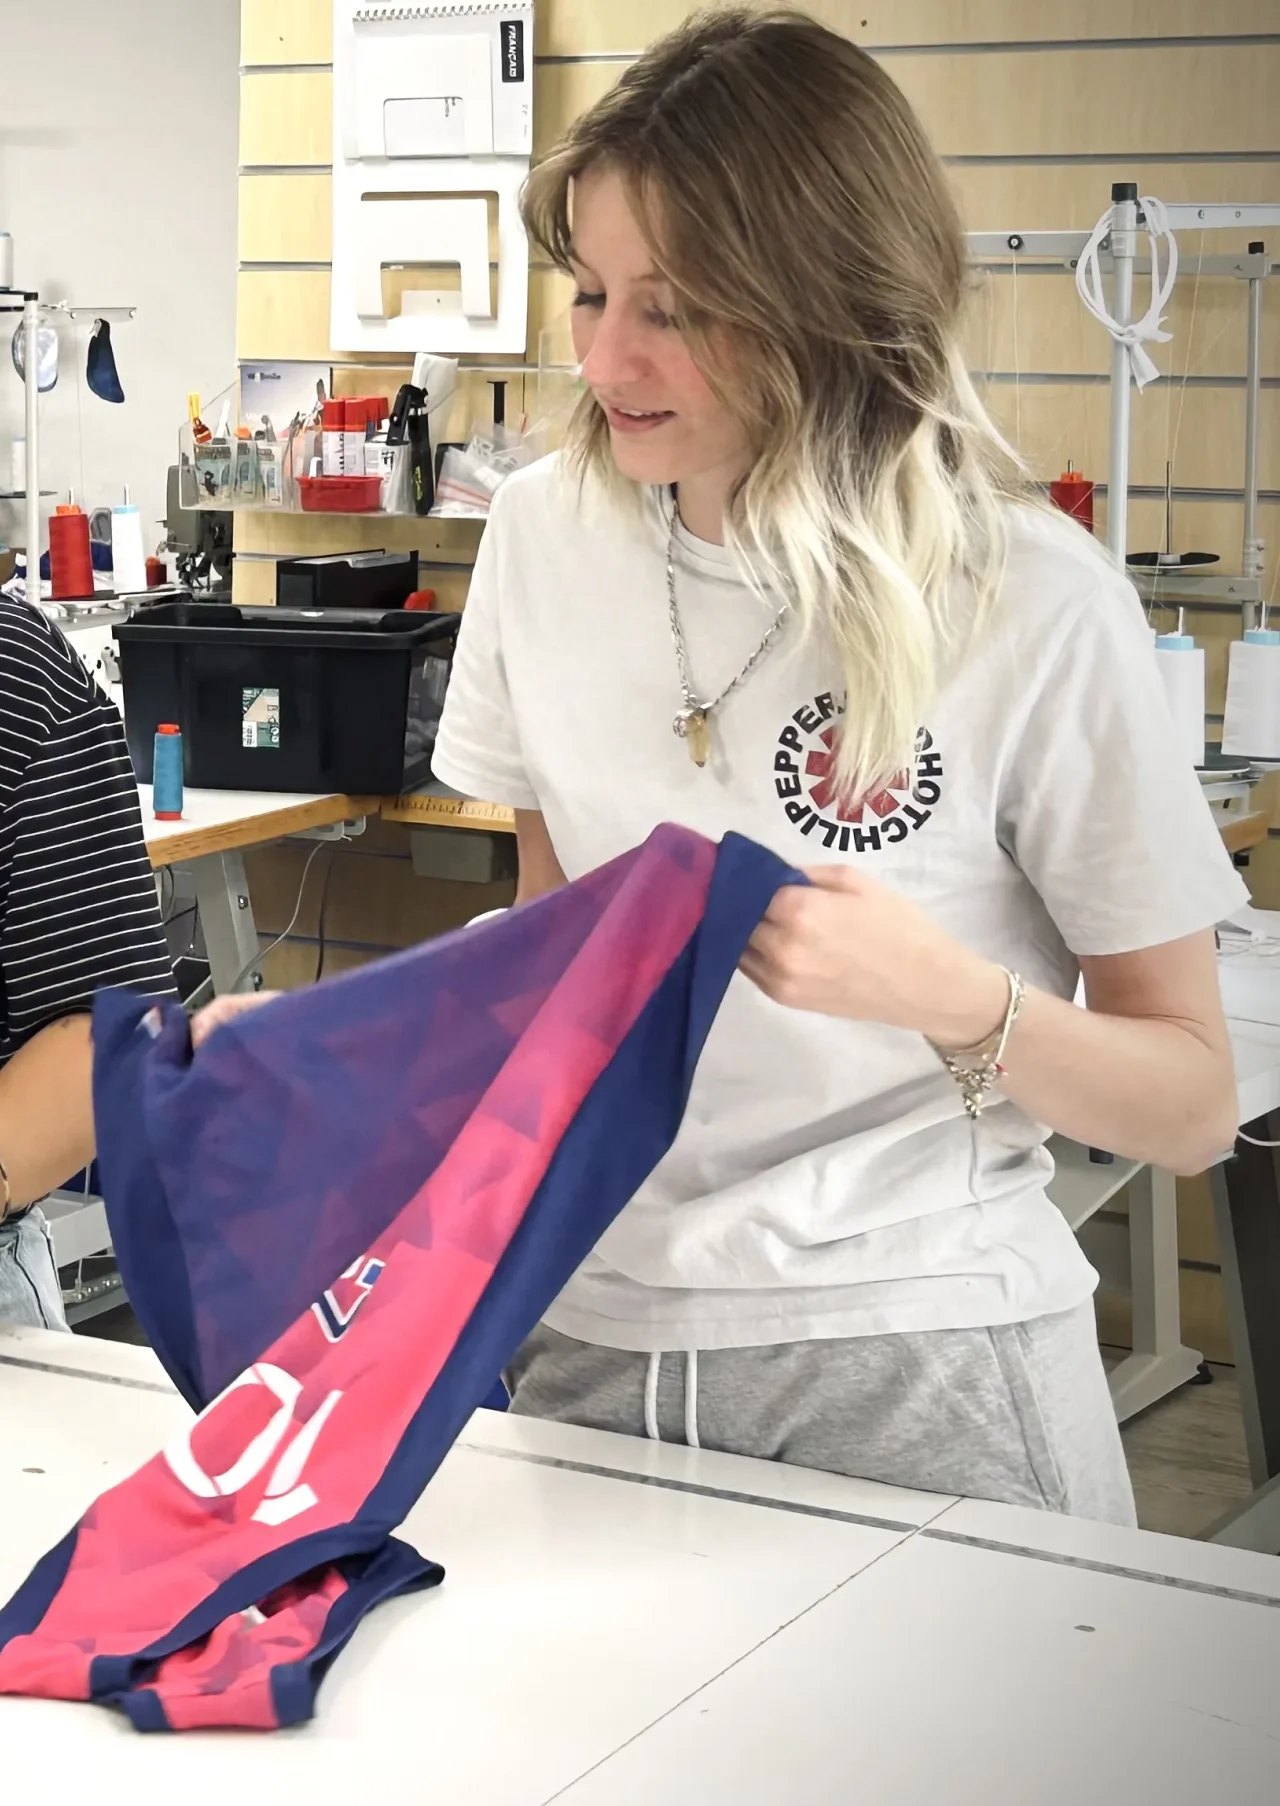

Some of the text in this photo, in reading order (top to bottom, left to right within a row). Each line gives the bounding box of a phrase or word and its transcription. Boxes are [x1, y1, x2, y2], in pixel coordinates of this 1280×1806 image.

[773, 689, 944, 853] HOT CHILI PEPPER
[162, 1362, 343, 1527] 10
